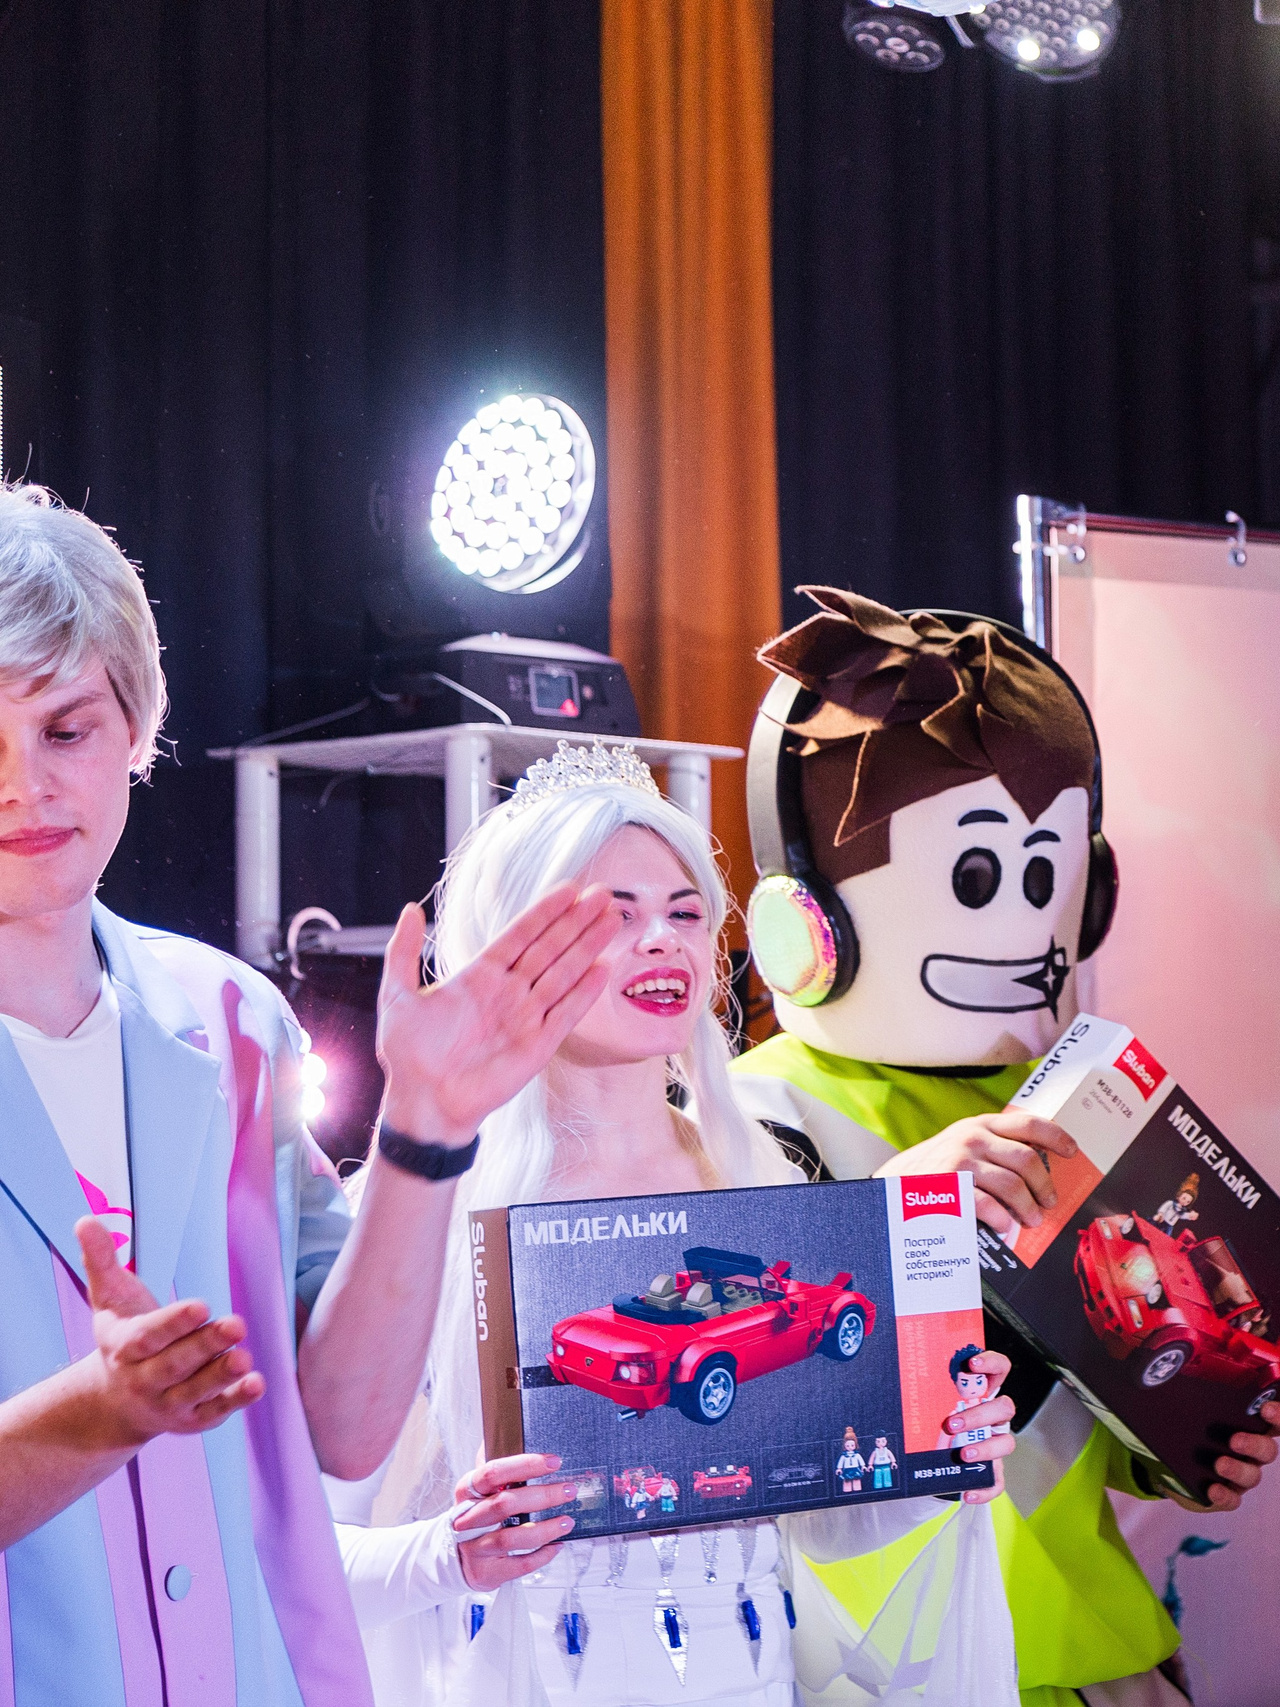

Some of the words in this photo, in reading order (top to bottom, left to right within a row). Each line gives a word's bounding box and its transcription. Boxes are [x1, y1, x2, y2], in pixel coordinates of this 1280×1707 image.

[1021, 1022, 1090, 1098] Sluban
[1122, 1049, 1156, 1089] Sluban
[1167, 1104, 1262, 1210] МОДЕЛЬКИ
[904, 1190, 956, 1207] Sluban
[523, 1210, 689, 1246] МОДЕЛЬКИ
[904, 1235, 946, 1248] Построй
[905, 1249, 931, 1259] свою
[905, 1257, 971, 1269] собственную
[471, 1221, 489, 1342] Sluban
[906, 1268, 954, 1281] историю!
[914, 1465, 961, 1480] M38-B1128
